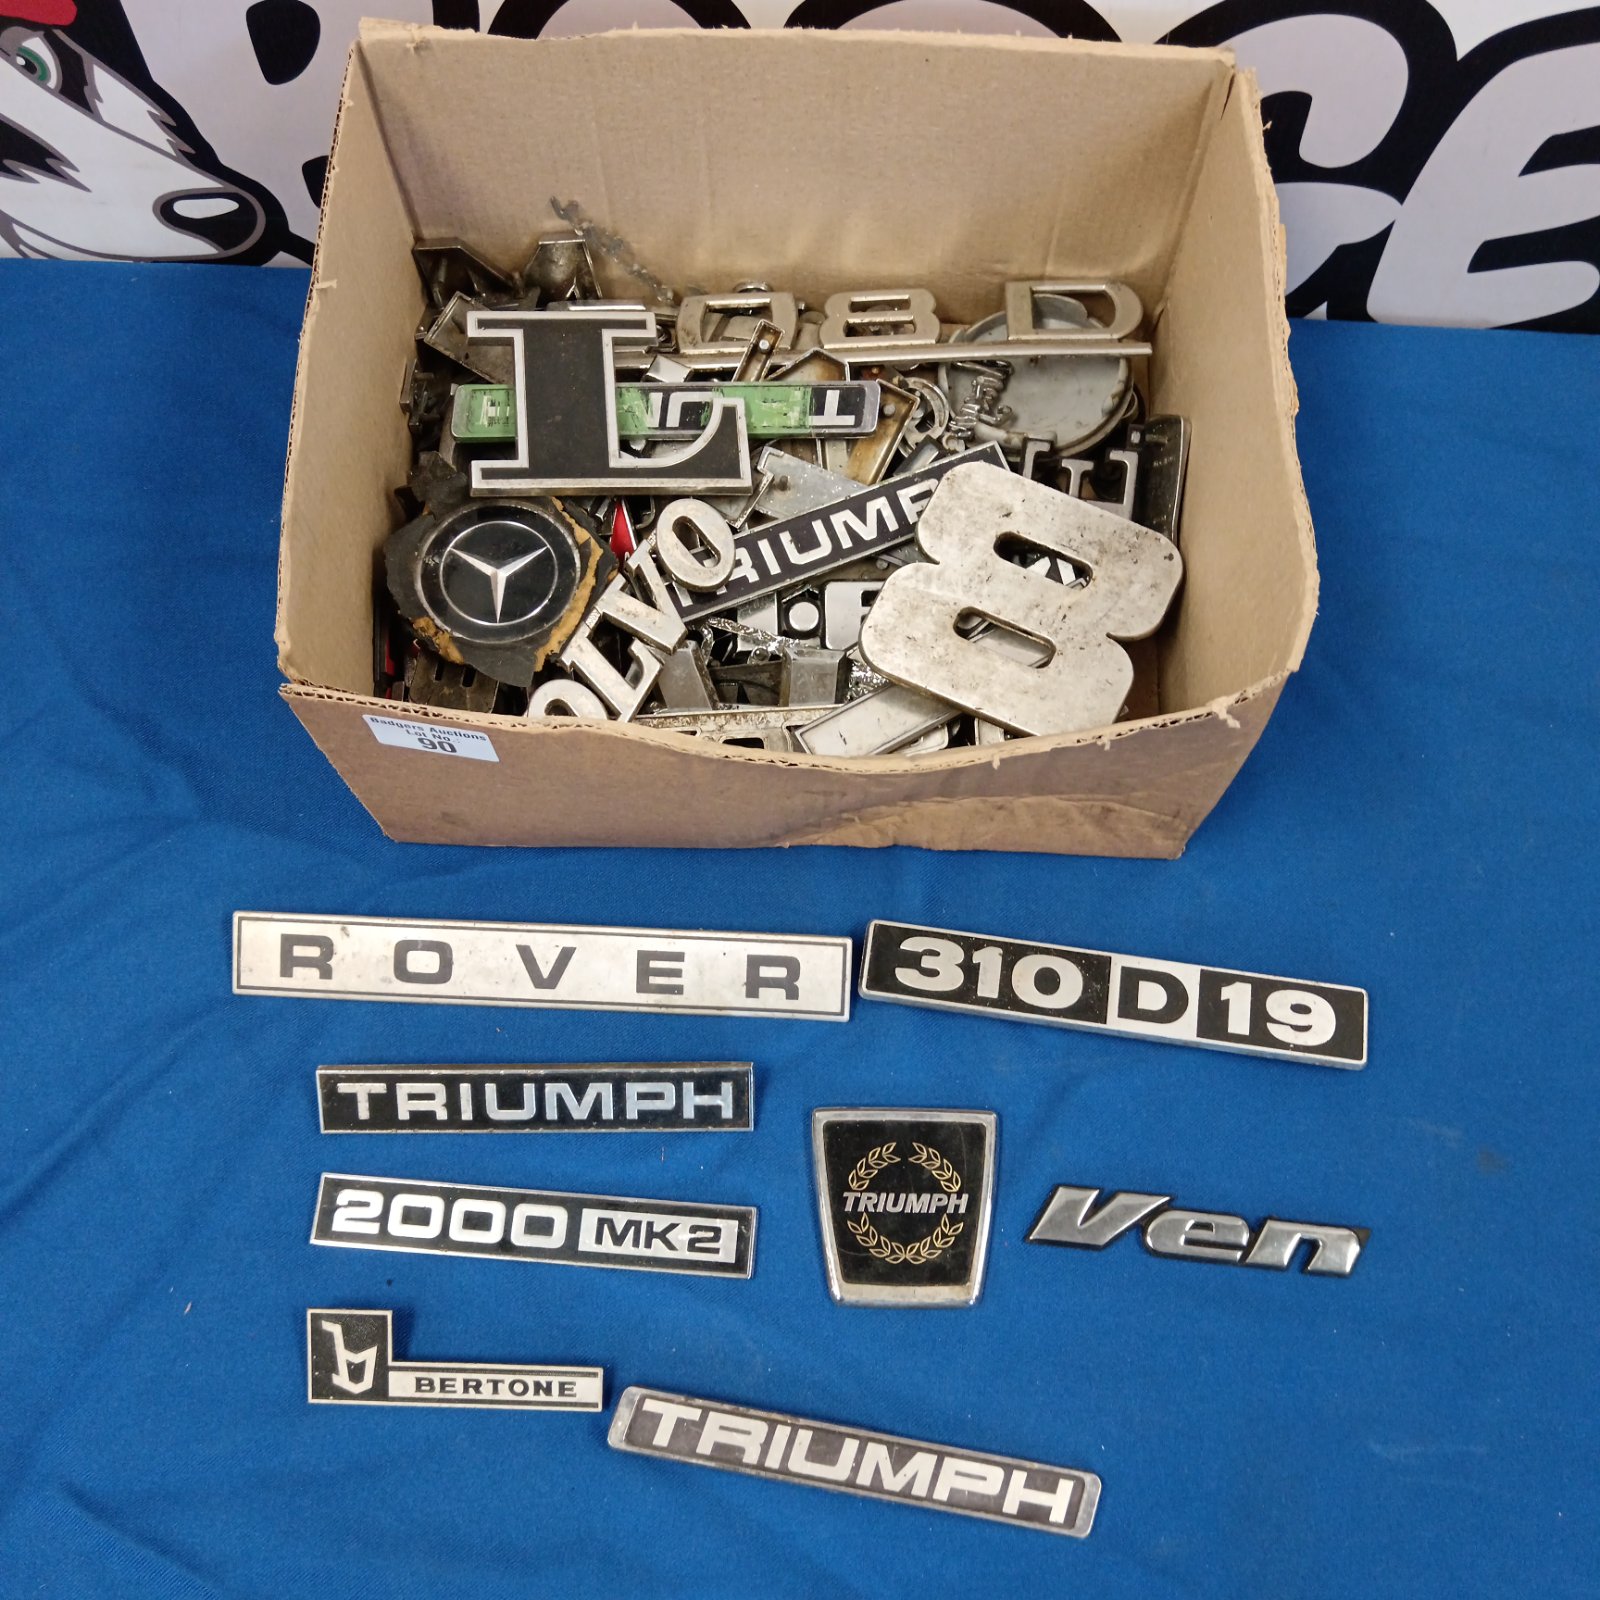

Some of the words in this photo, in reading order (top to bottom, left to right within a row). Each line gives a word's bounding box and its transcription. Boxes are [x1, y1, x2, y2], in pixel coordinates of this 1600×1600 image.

[369, 716, 425, 732] Badgers
[430, 726, 487, 741] Auctions
[406, 729, 427, 738] Lot
[417, 737, 457, 753] 90
[279, 933, 801, 1001] ROVER
[336, 1082, 733, 1121] TRIUMPH
[842, 1191, 969, 1215] TRIUMPH
[331, 1189, 569, 1249] 2000
[594, 1216, 722, 1255] MK2
[414, 1376, 577, 1398] BERTONE
[642, 1398, 1075, 1524] TRIUMPH
